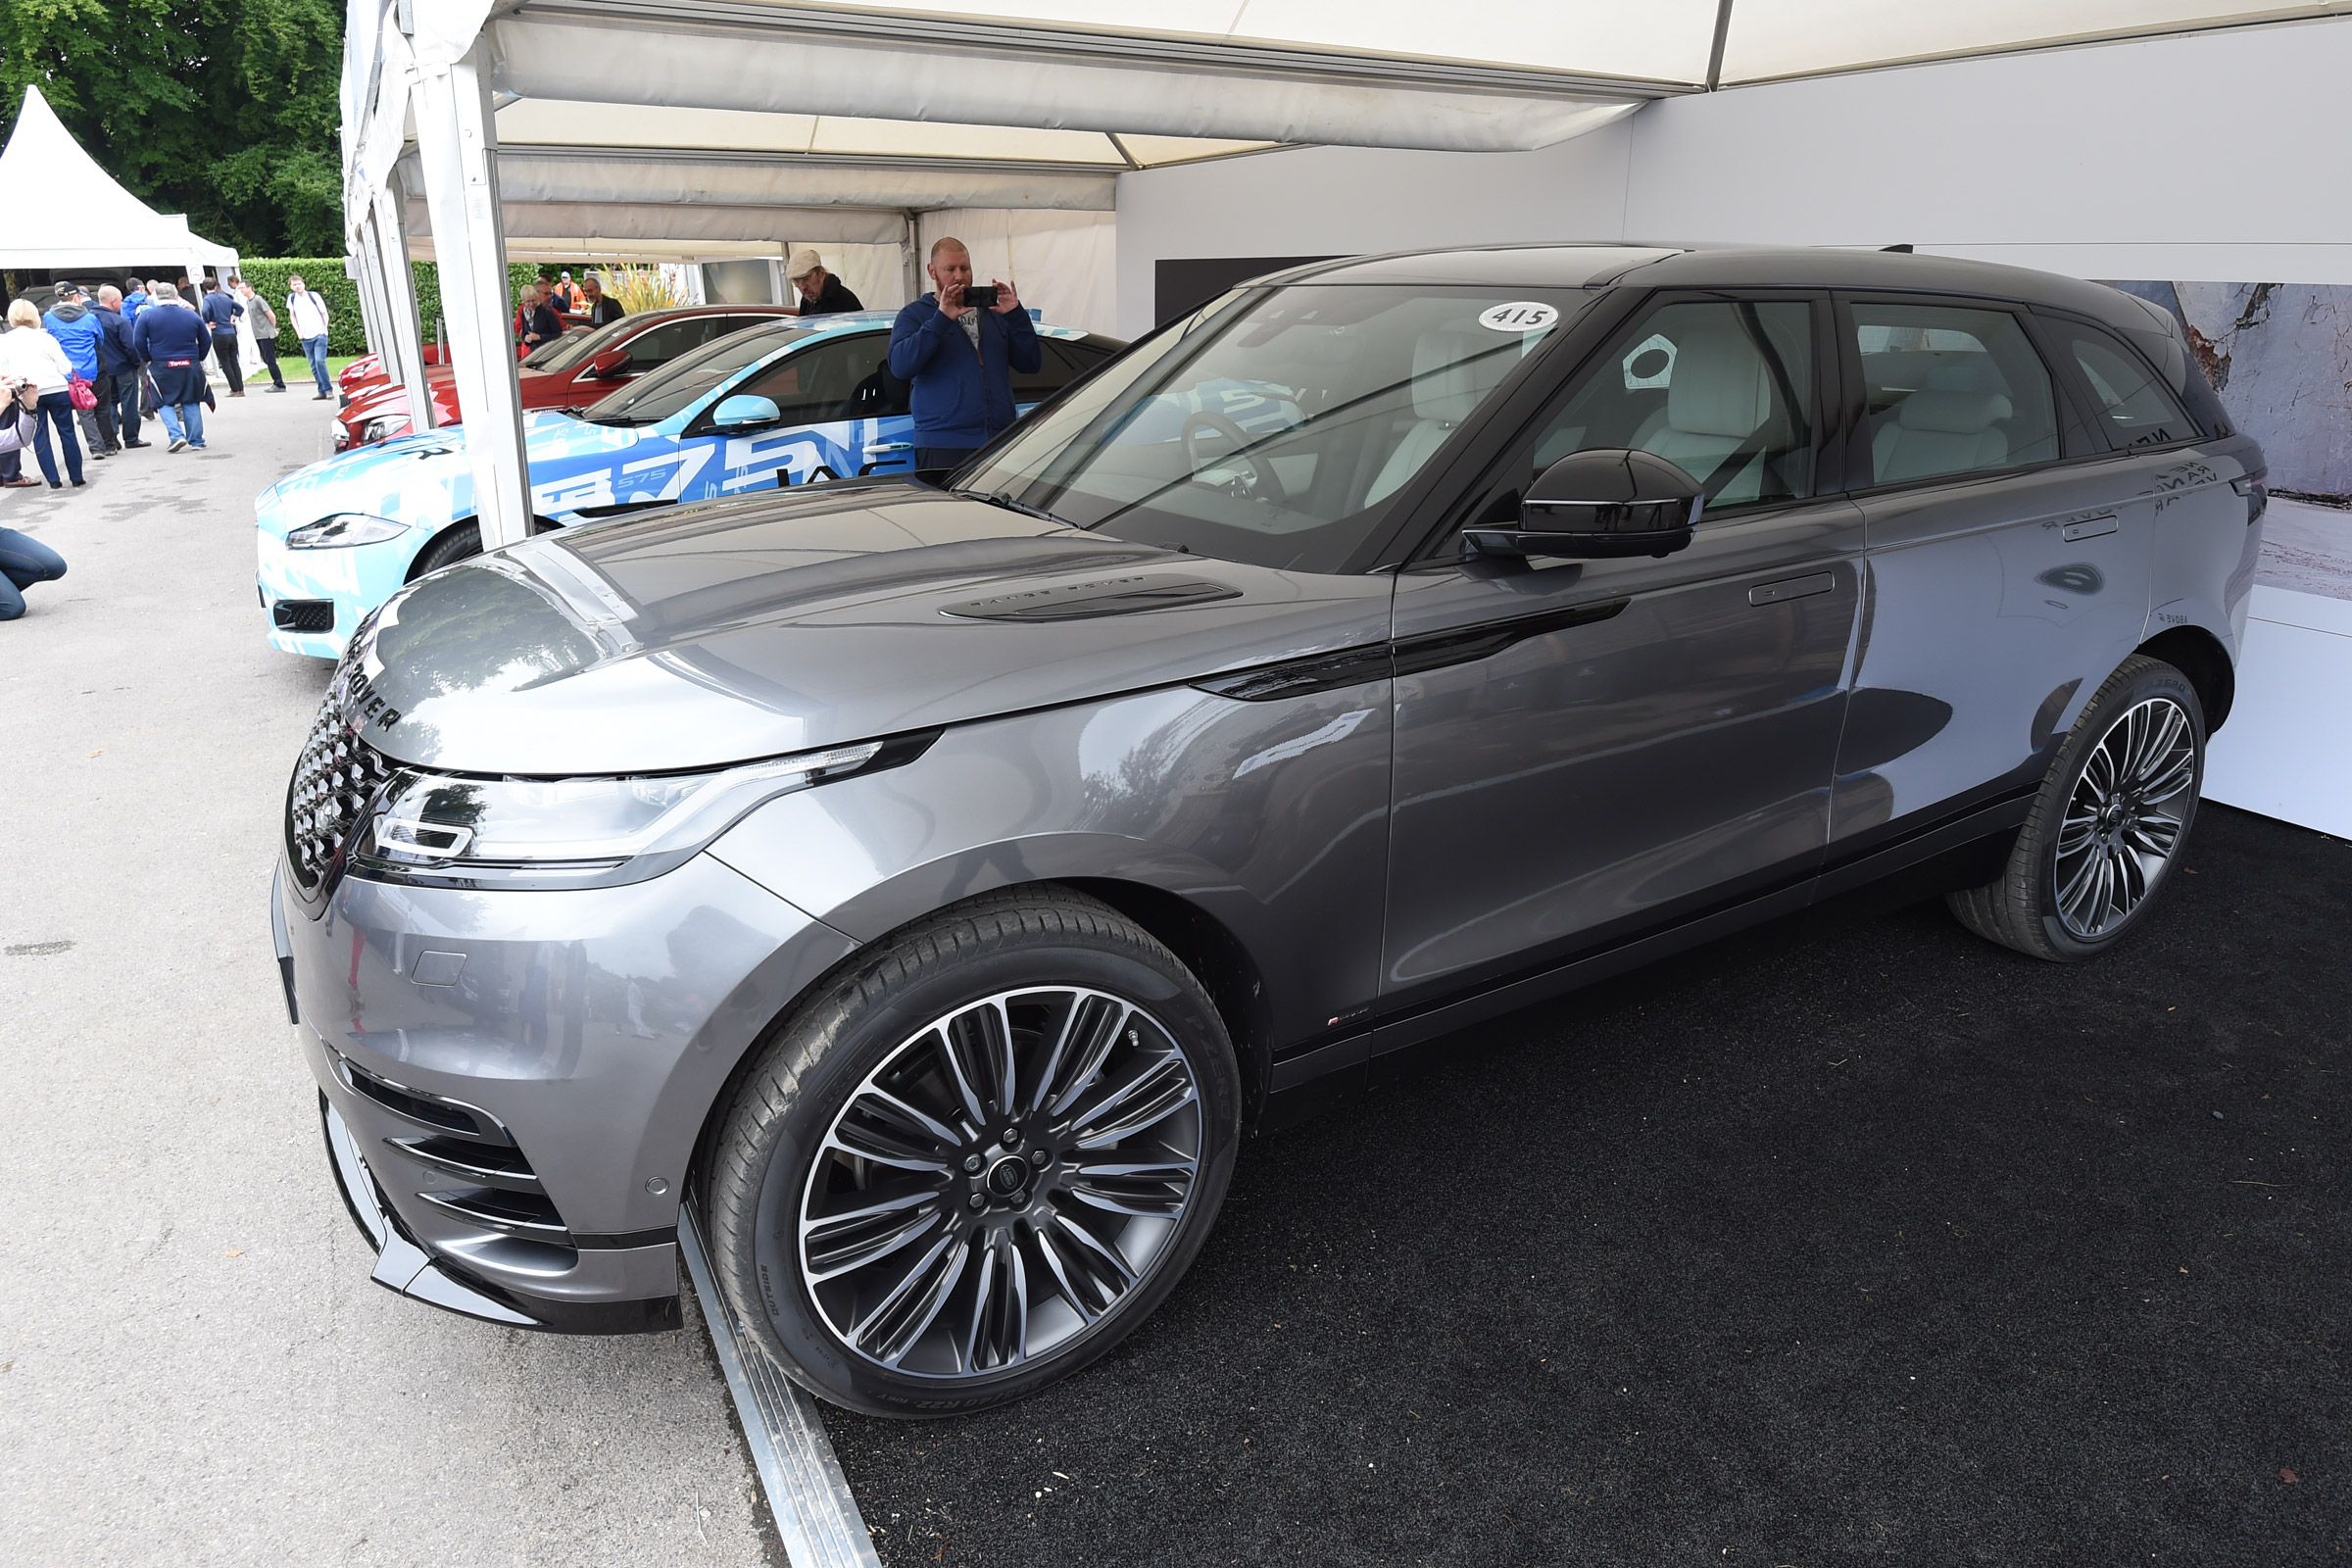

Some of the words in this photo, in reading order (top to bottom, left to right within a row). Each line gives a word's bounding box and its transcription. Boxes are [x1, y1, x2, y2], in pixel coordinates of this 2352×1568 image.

[1492, 308, 1549, 325] 415
[617, 467, 666, 489] 575
[1067, 576, 1146, 591] ROVER
[760, 1264, 780, 1316] OUTSIDE
